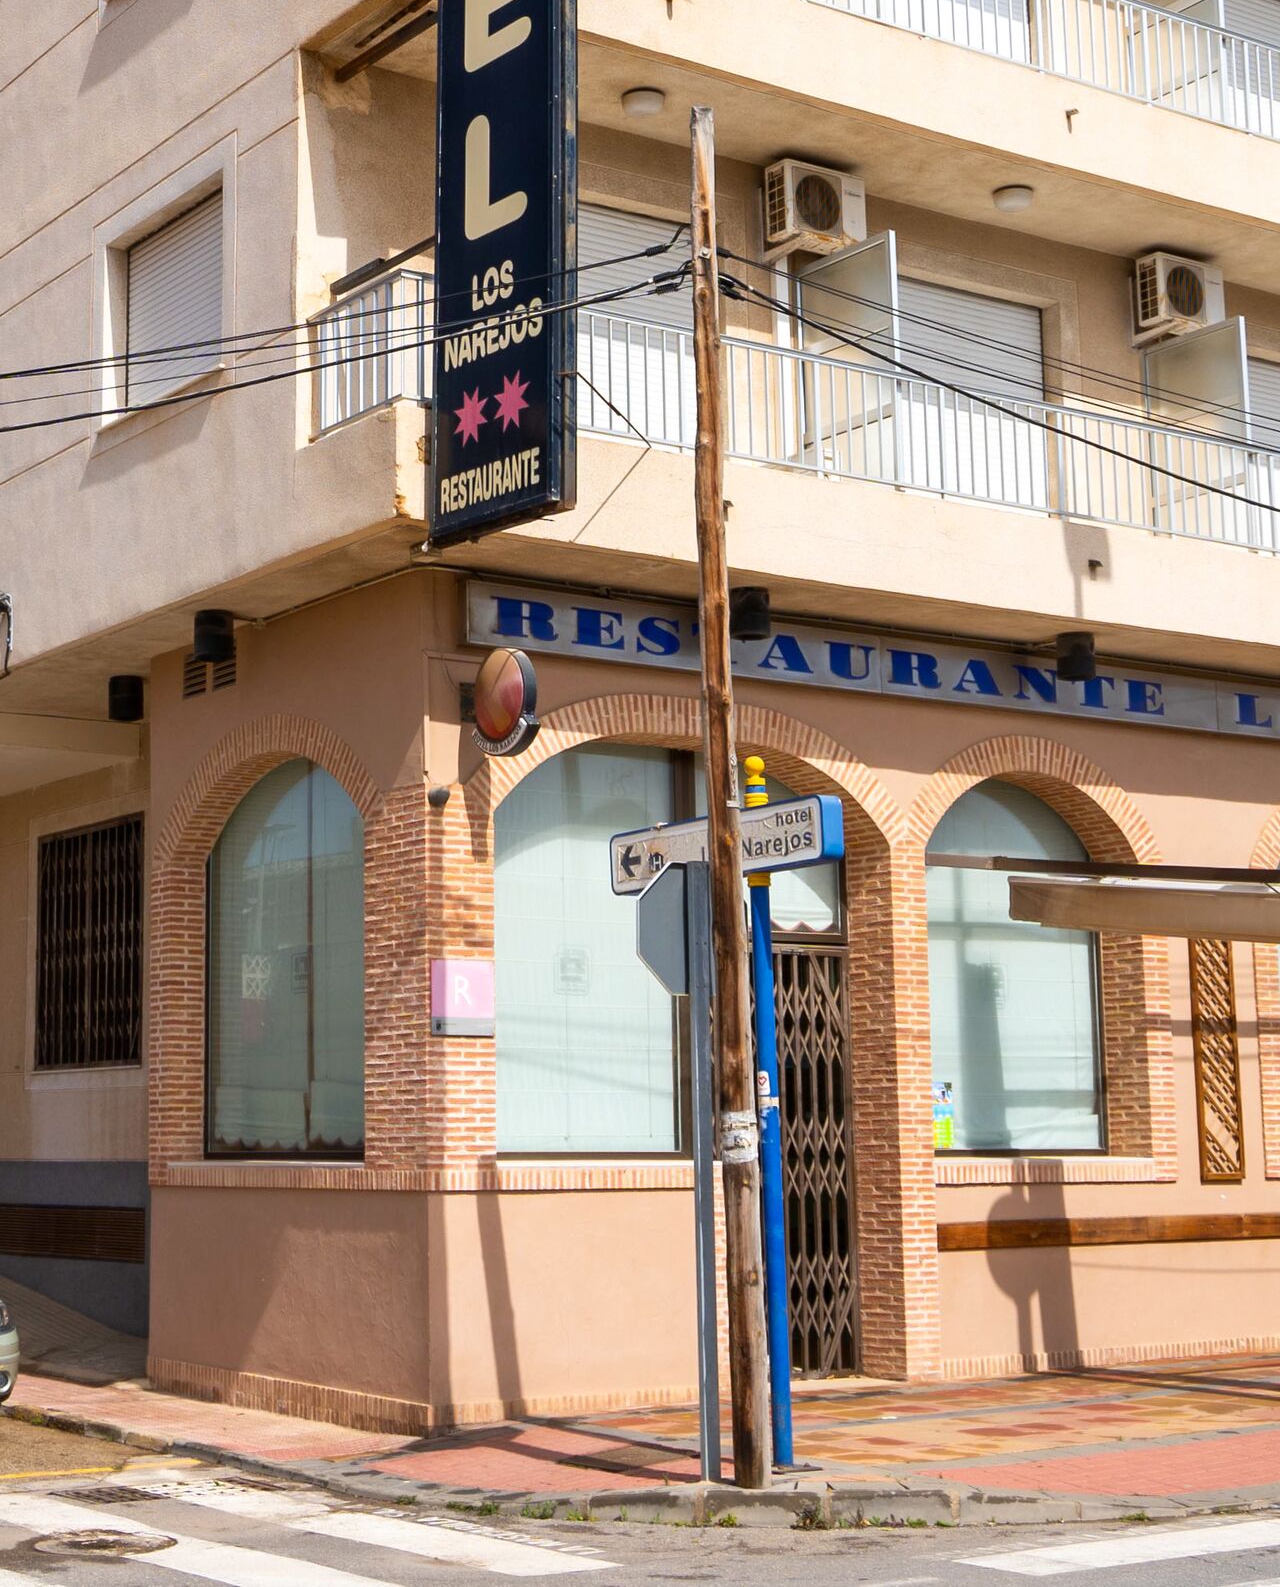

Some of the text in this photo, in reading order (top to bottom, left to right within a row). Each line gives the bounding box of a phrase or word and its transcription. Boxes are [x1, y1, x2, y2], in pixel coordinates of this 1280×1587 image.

[472, 260, 514, 311] LOS
[444, 297, 543, 373] NAREJOS
[440, 446, 540, 515] RESTAURANTE
[490, 595, 1166, 716] RESAURANTE
[775, 806, 812, 828] hotel
[742, 830, 813, 857] Narejos
[453, 975, 473, 1006] R
